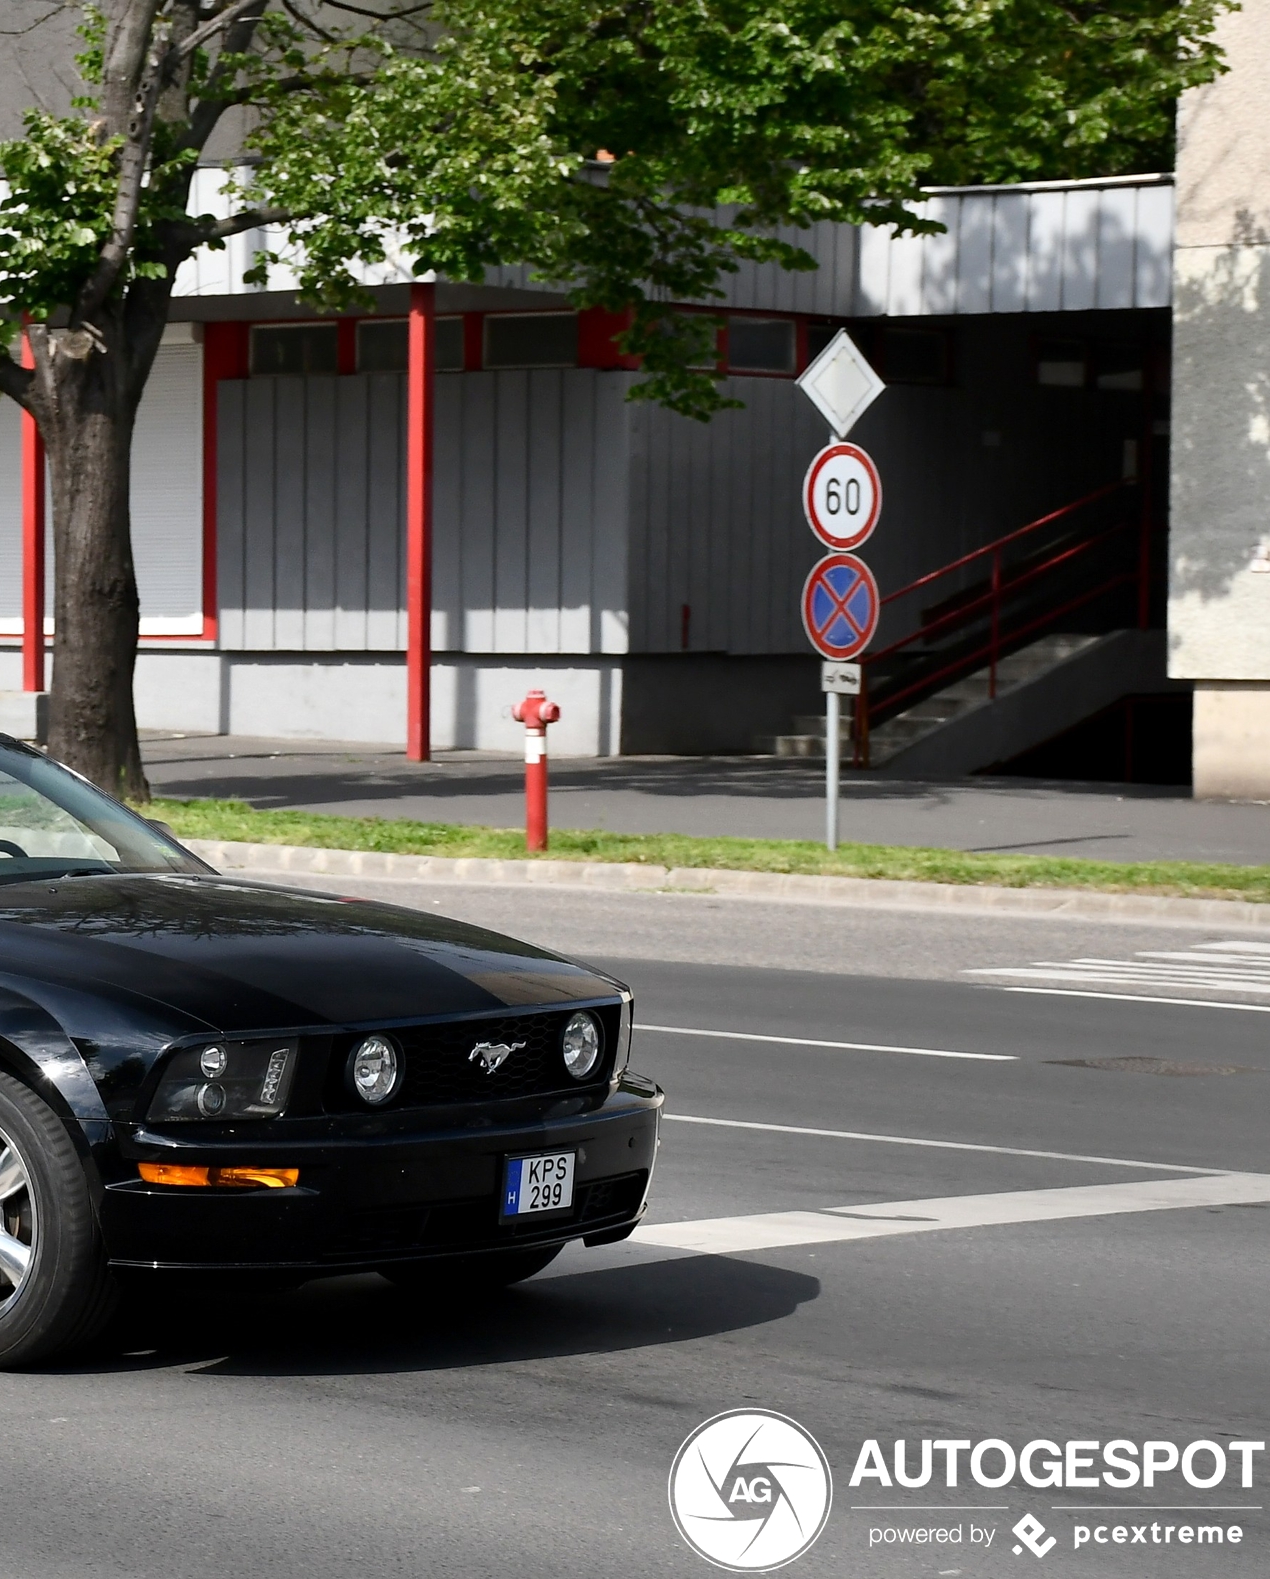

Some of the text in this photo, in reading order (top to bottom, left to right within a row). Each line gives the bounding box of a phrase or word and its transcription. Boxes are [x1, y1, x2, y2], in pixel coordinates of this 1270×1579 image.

[826, 478, 860, 515] 60
[529, 1157, 566, 1184] KPS
[508, 1191, 516, 1204] H
[530, 1183, 562, 1208] 299
